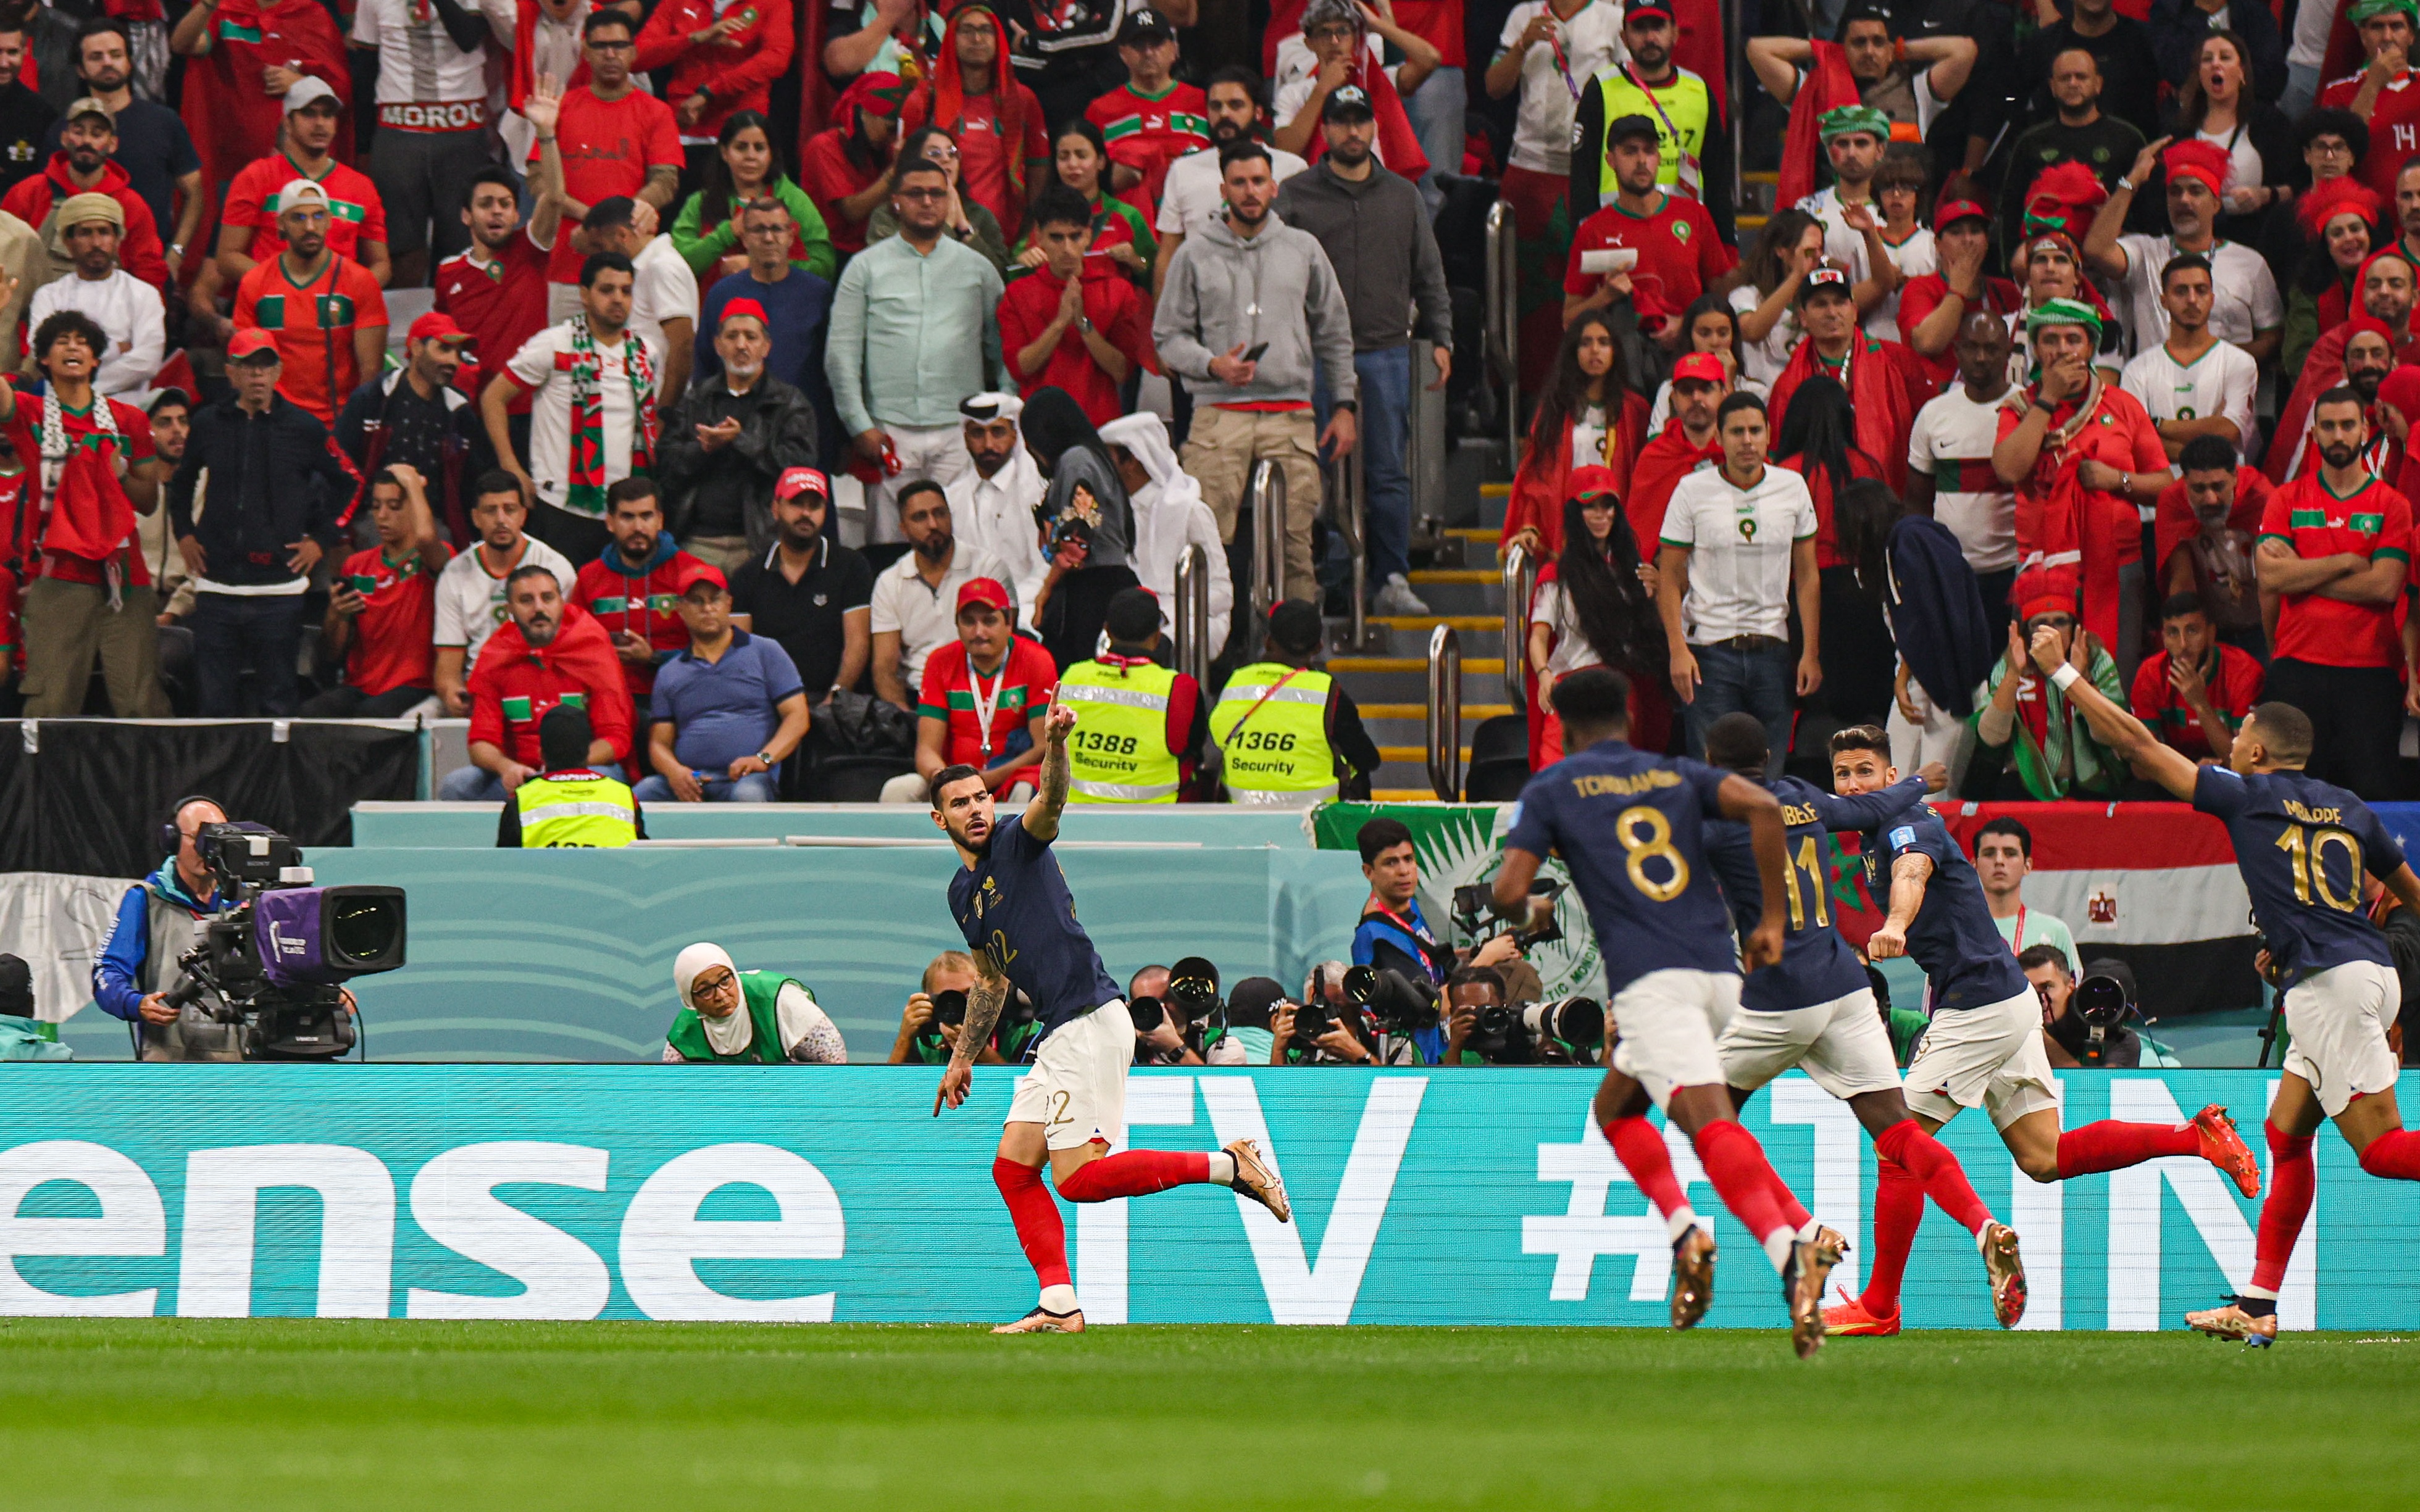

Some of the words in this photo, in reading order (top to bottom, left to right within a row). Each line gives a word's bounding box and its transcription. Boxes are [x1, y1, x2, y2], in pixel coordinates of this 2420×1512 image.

[2392, 123, 2416, 151] 14
[1075, 730, 1138, 755] 1388
[1235, 731, 1298, 752] 1366
[1075, 751, 1138, 772] Security
[1232, 757, 1295, 776] Security
[1616, 806, 1690, 902] 8
[2275, 823, 2361, 913] 10
[1784, 835, 1830, 931] 11
[1014, 1076, 1430, 1326] TV
